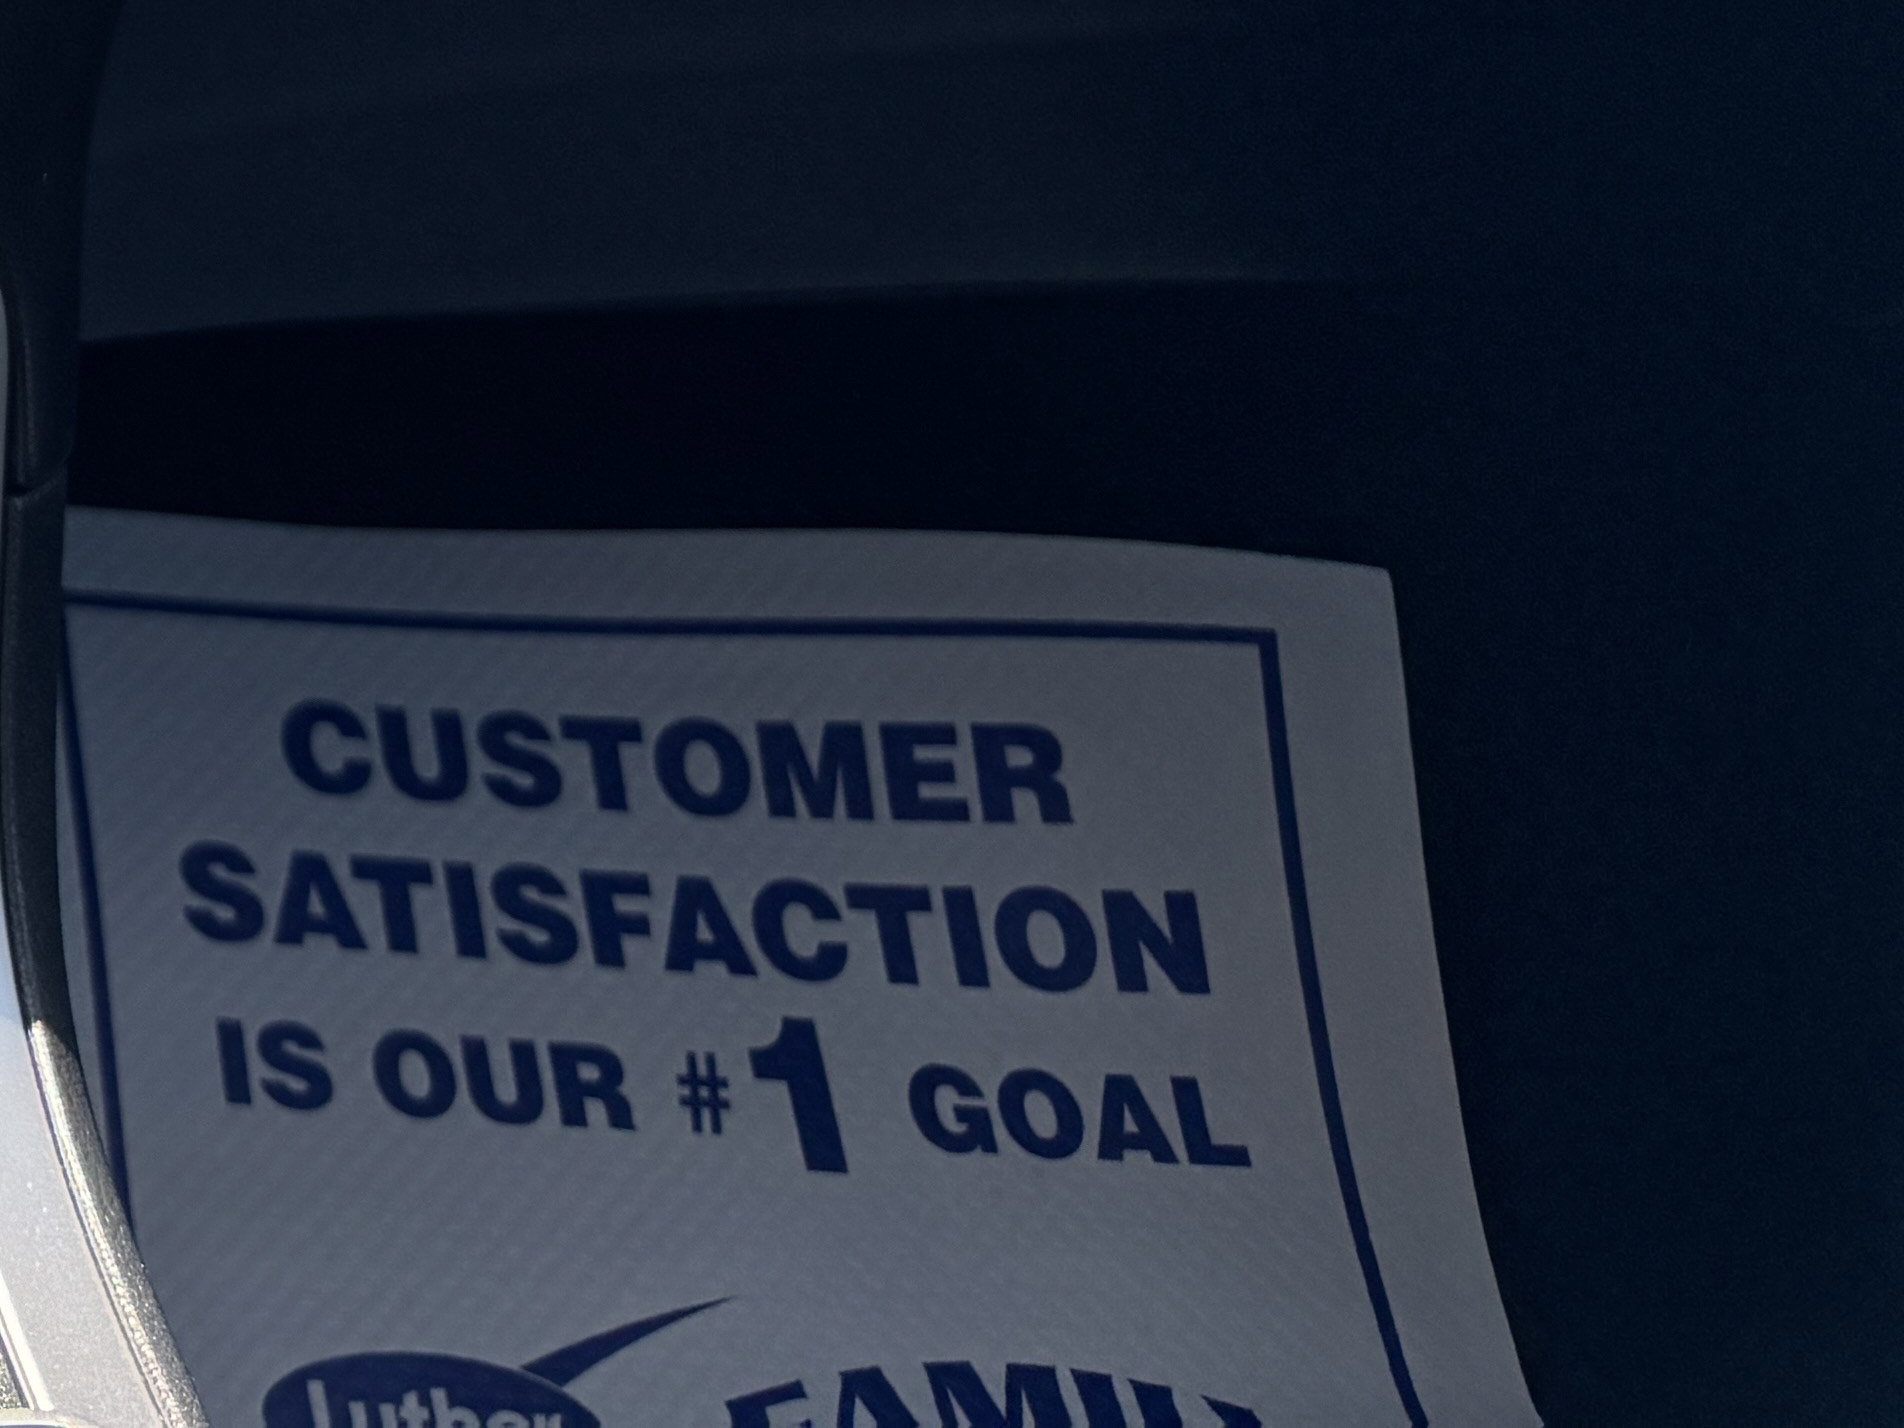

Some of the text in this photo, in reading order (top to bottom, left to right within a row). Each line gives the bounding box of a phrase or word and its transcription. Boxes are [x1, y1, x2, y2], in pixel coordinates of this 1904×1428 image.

[278, 697, 1073, 825] CUSTOMER
[176, 839, 1211, 995] SATISFACTION
[216, 1017, 334, 1113] IS
[371, 1028, 637, 1132] OUR
[907, 1062, 1253, 1169] GOAL
